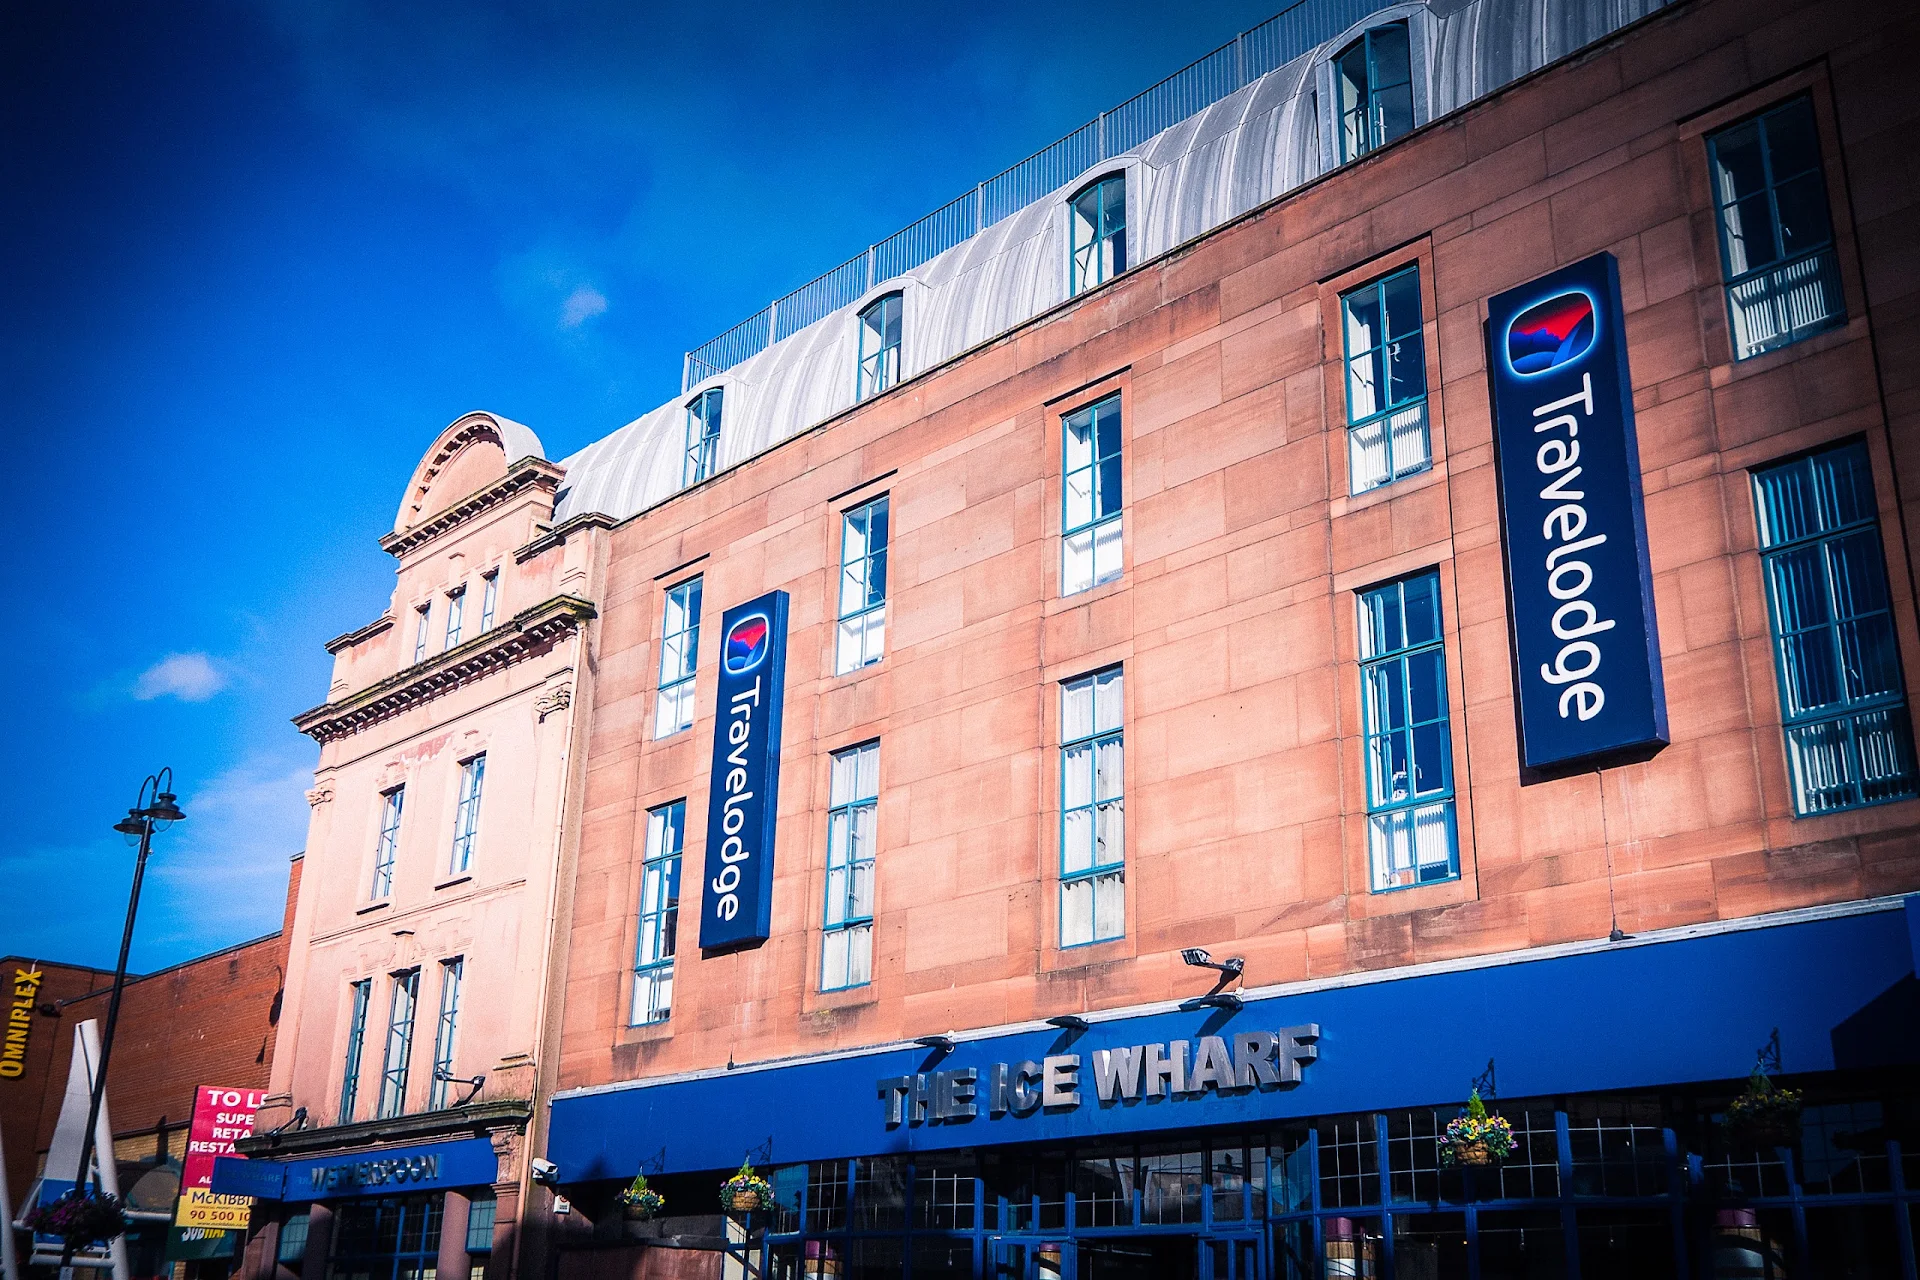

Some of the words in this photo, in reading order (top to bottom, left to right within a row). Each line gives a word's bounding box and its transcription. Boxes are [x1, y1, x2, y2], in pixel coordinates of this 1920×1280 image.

[1532, 371, 1616, 722] Travelodge
[712, 674, 761, 922] Travelodge
[0, 968, 43, 1078] OMNIPLEX
[877, 1066, 976, 1129] THE
[990, 1053, 1081, 1118] ICE
[1092, 1022, 1320, 1106] WHARF
[207, 1090, 242, 1107] TO
[215, 1112, 255, 1126] SUPE
[212, 1127, 252, 1140] RETA
[189, 1141, 236, 1154] RESTA
[311, 1153, 440, 1191] WETHERSPOON
[190, 1210, 206, 1220] 90
[210, 1211, 235, 1221] 500
